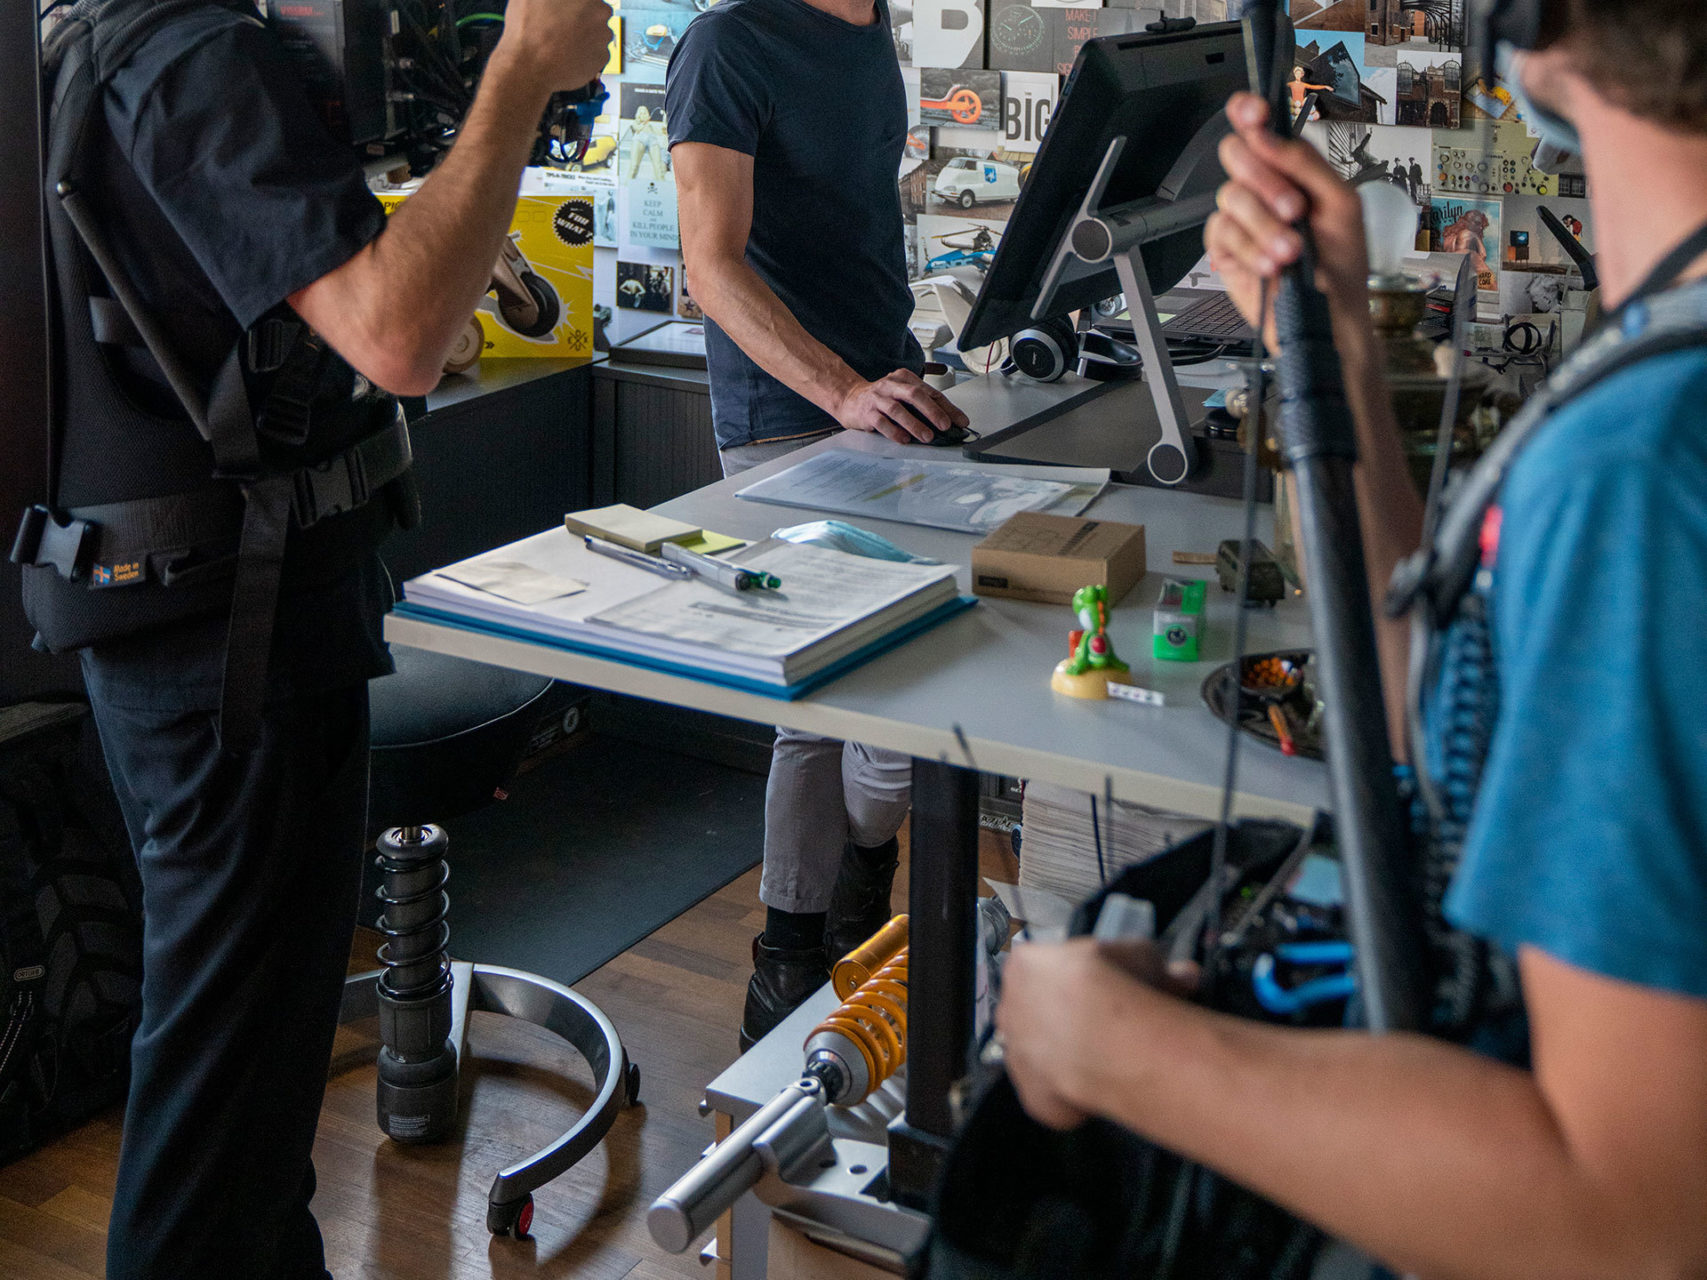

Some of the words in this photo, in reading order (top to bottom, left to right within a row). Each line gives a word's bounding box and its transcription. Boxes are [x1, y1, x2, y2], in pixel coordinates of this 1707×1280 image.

[1006, 97, 1051, 142] BIG
[644, 200, 662, 209] KEEP
[568, 211, 590, 226] FOR
[642, 209, 664, 218] CALM
[556, 217, 583, 235] WHAT
[632, 222, 649, 230] KILL
[650, 222, 674, 231] PEOPLE
[638, 231, 658, 240] YOUR
[659, 232, 678, 241] MIND
